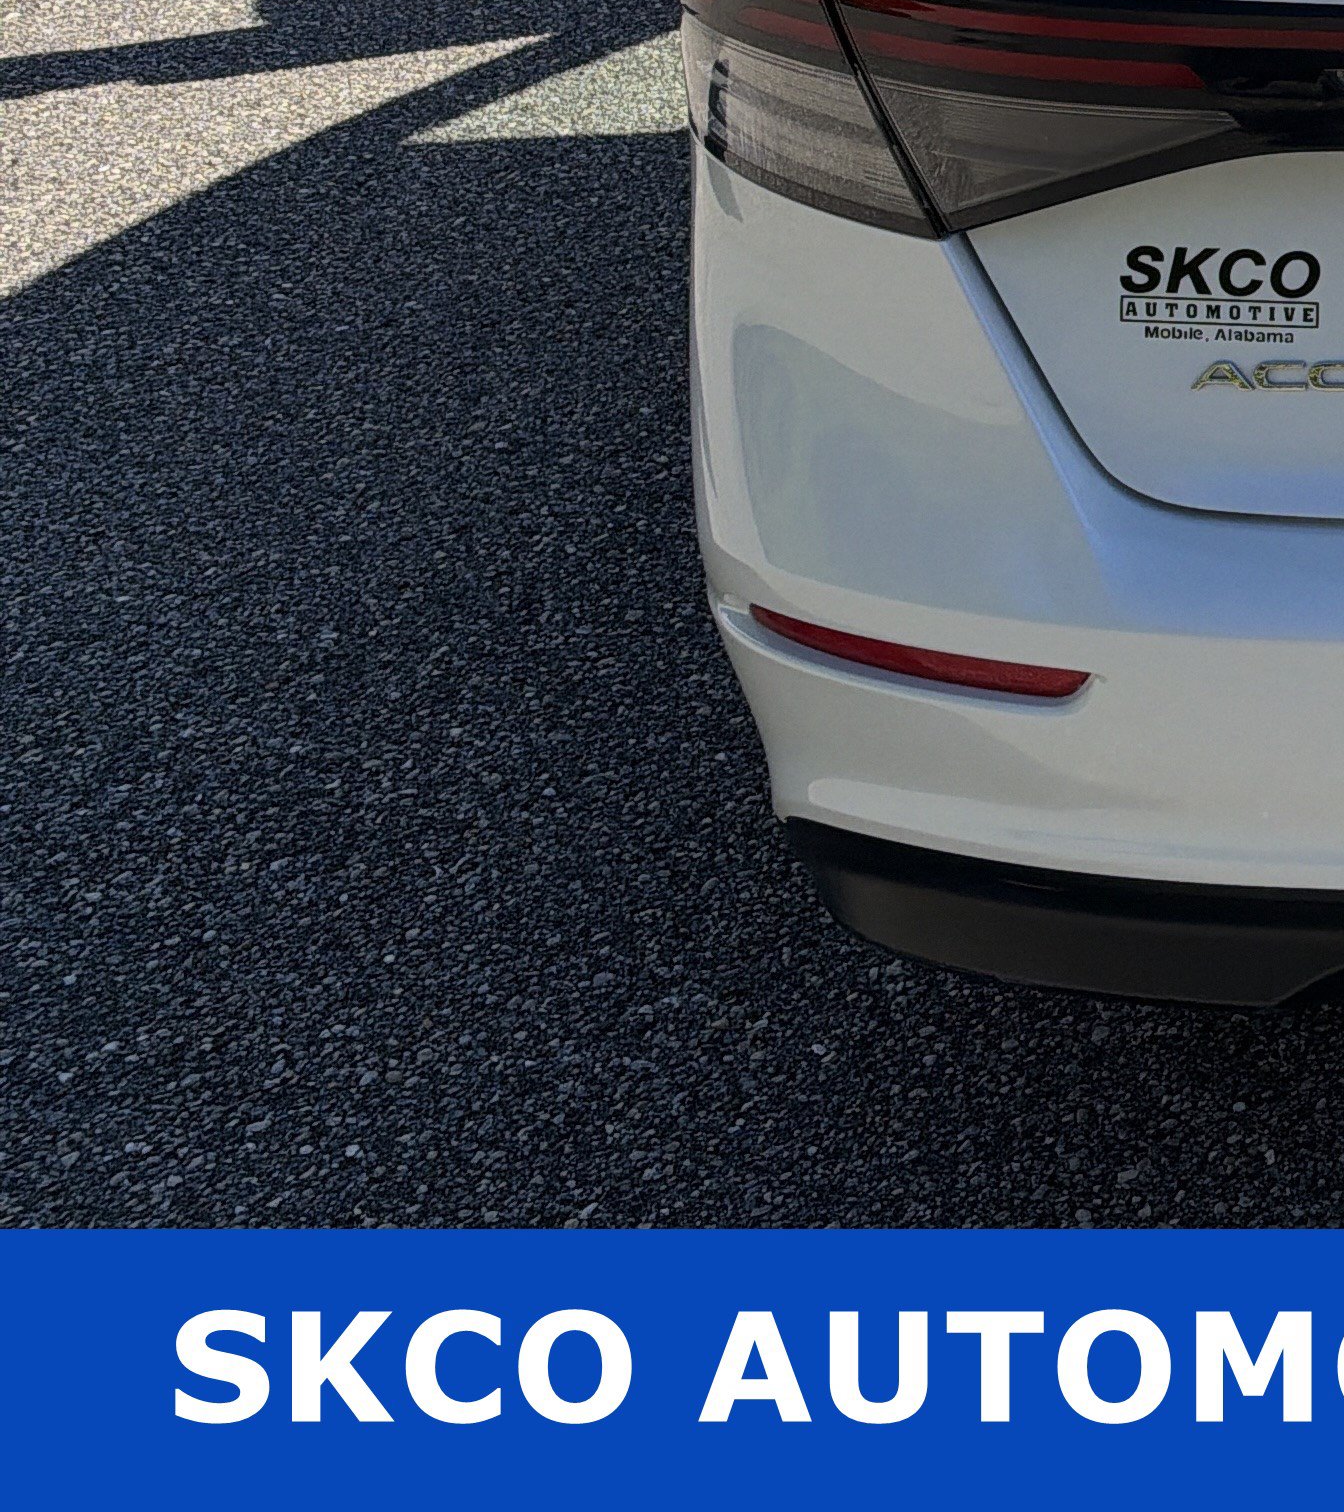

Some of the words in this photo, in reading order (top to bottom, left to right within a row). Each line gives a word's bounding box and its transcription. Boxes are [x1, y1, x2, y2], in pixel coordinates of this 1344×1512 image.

[1119, 245, 1321, 299] SKCO
[1124, 301, 1315, 323] AUTOMOTIVE
[1214, 327, 1295, 344] Alabama
